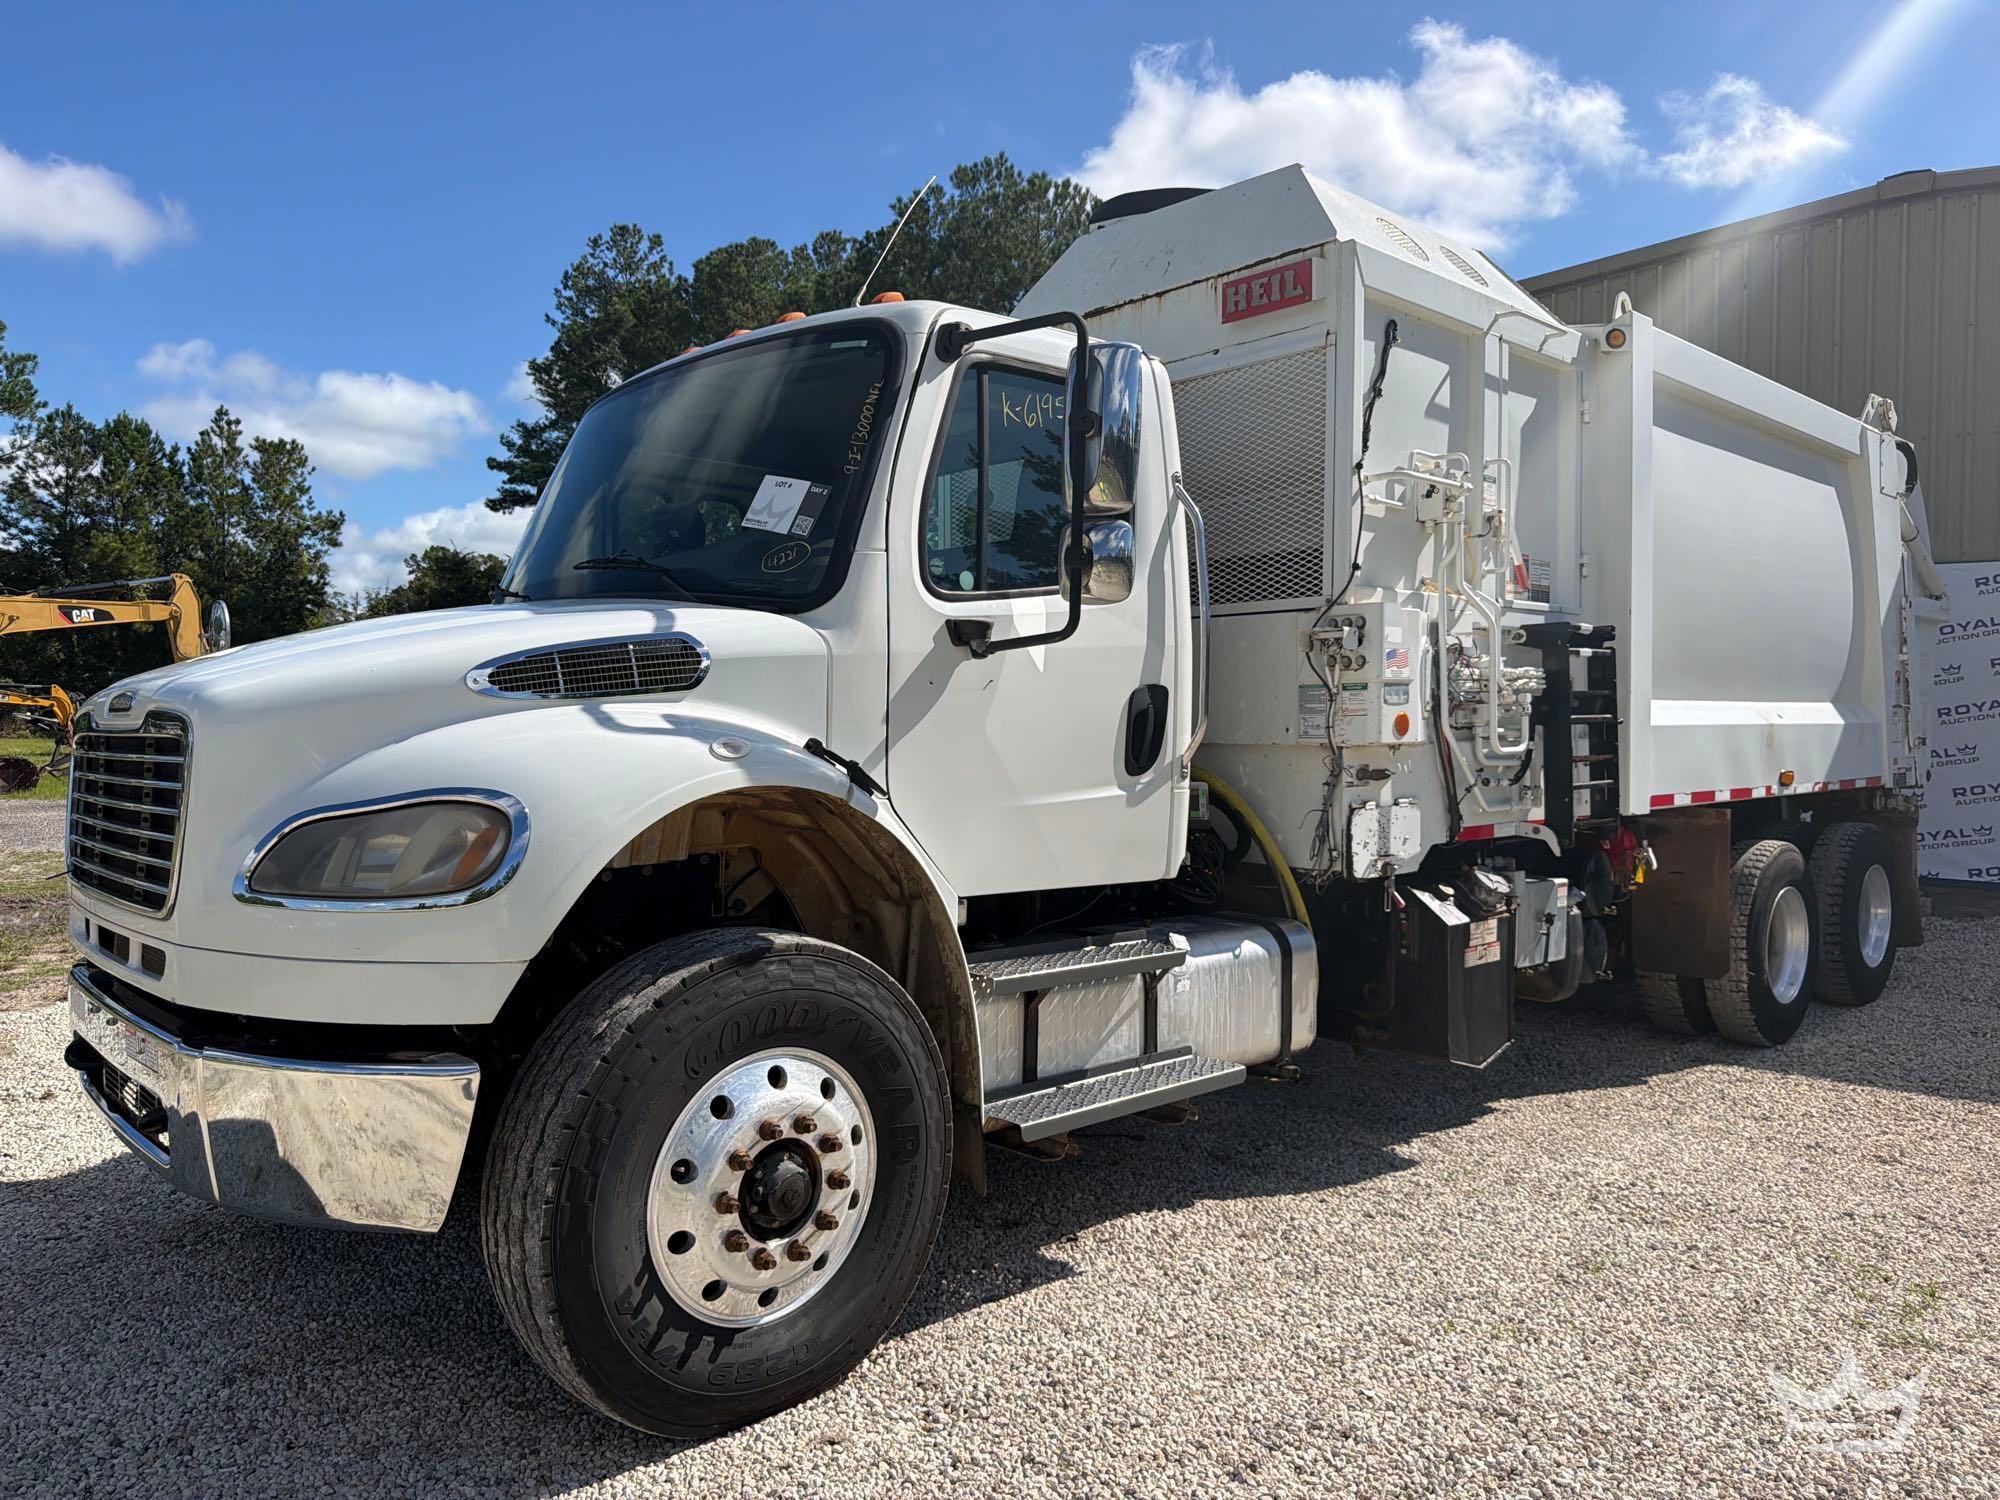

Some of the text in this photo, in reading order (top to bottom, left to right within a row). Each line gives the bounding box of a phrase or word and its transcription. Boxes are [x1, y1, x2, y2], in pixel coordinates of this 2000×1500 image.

[1226, 270, 1304, 313] HEIL
[810, 486, 823, 494] DAY
[72, 608, 95, 623] CAT
[1940, 713, 1995, 726] AUCTION
[1936, 756, 1980, 768] GROUP
[1917, 838, 1996, 850] TION GROUP
